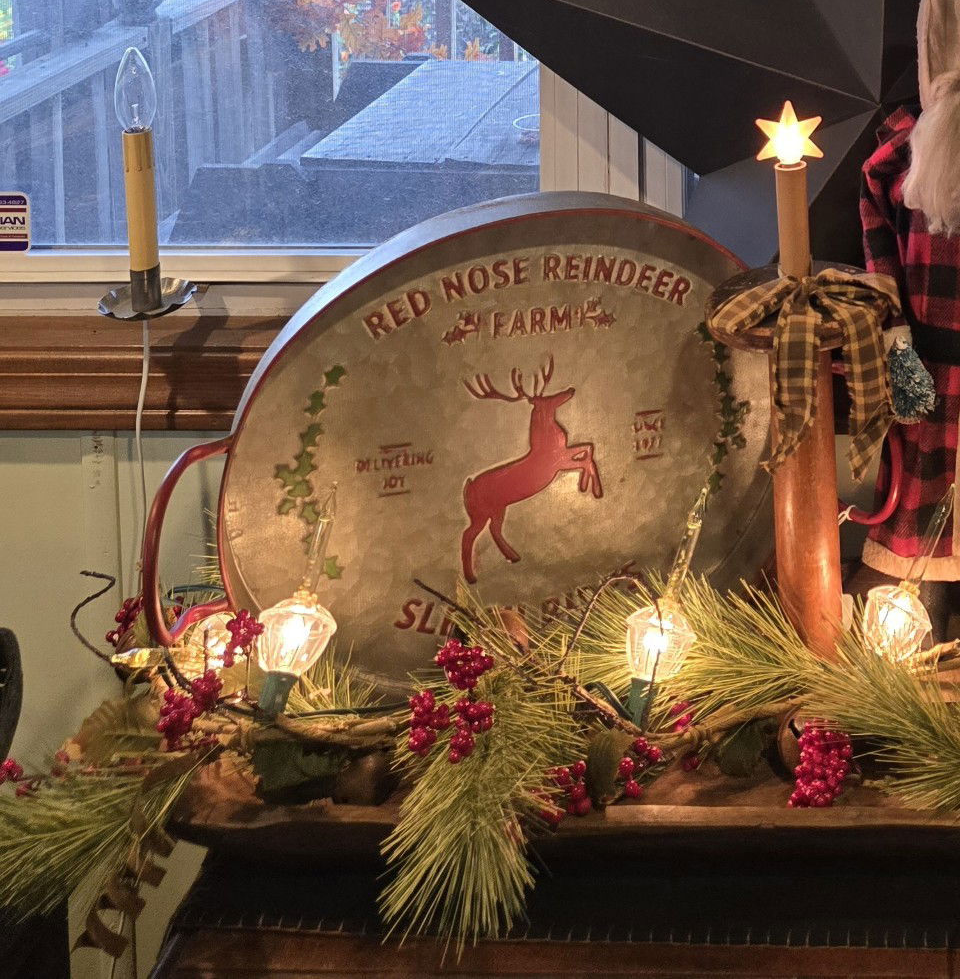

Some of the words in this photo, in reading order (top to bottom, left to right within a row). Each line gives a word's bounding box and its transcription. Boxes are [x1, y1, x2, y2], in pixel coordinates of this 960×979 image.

[363, 288, 432, 341] RED
[441, 257, 530, 303] NOSE
[543, 254, 692, 307] REINDEER
[491, 304, 573, 339] FARM
